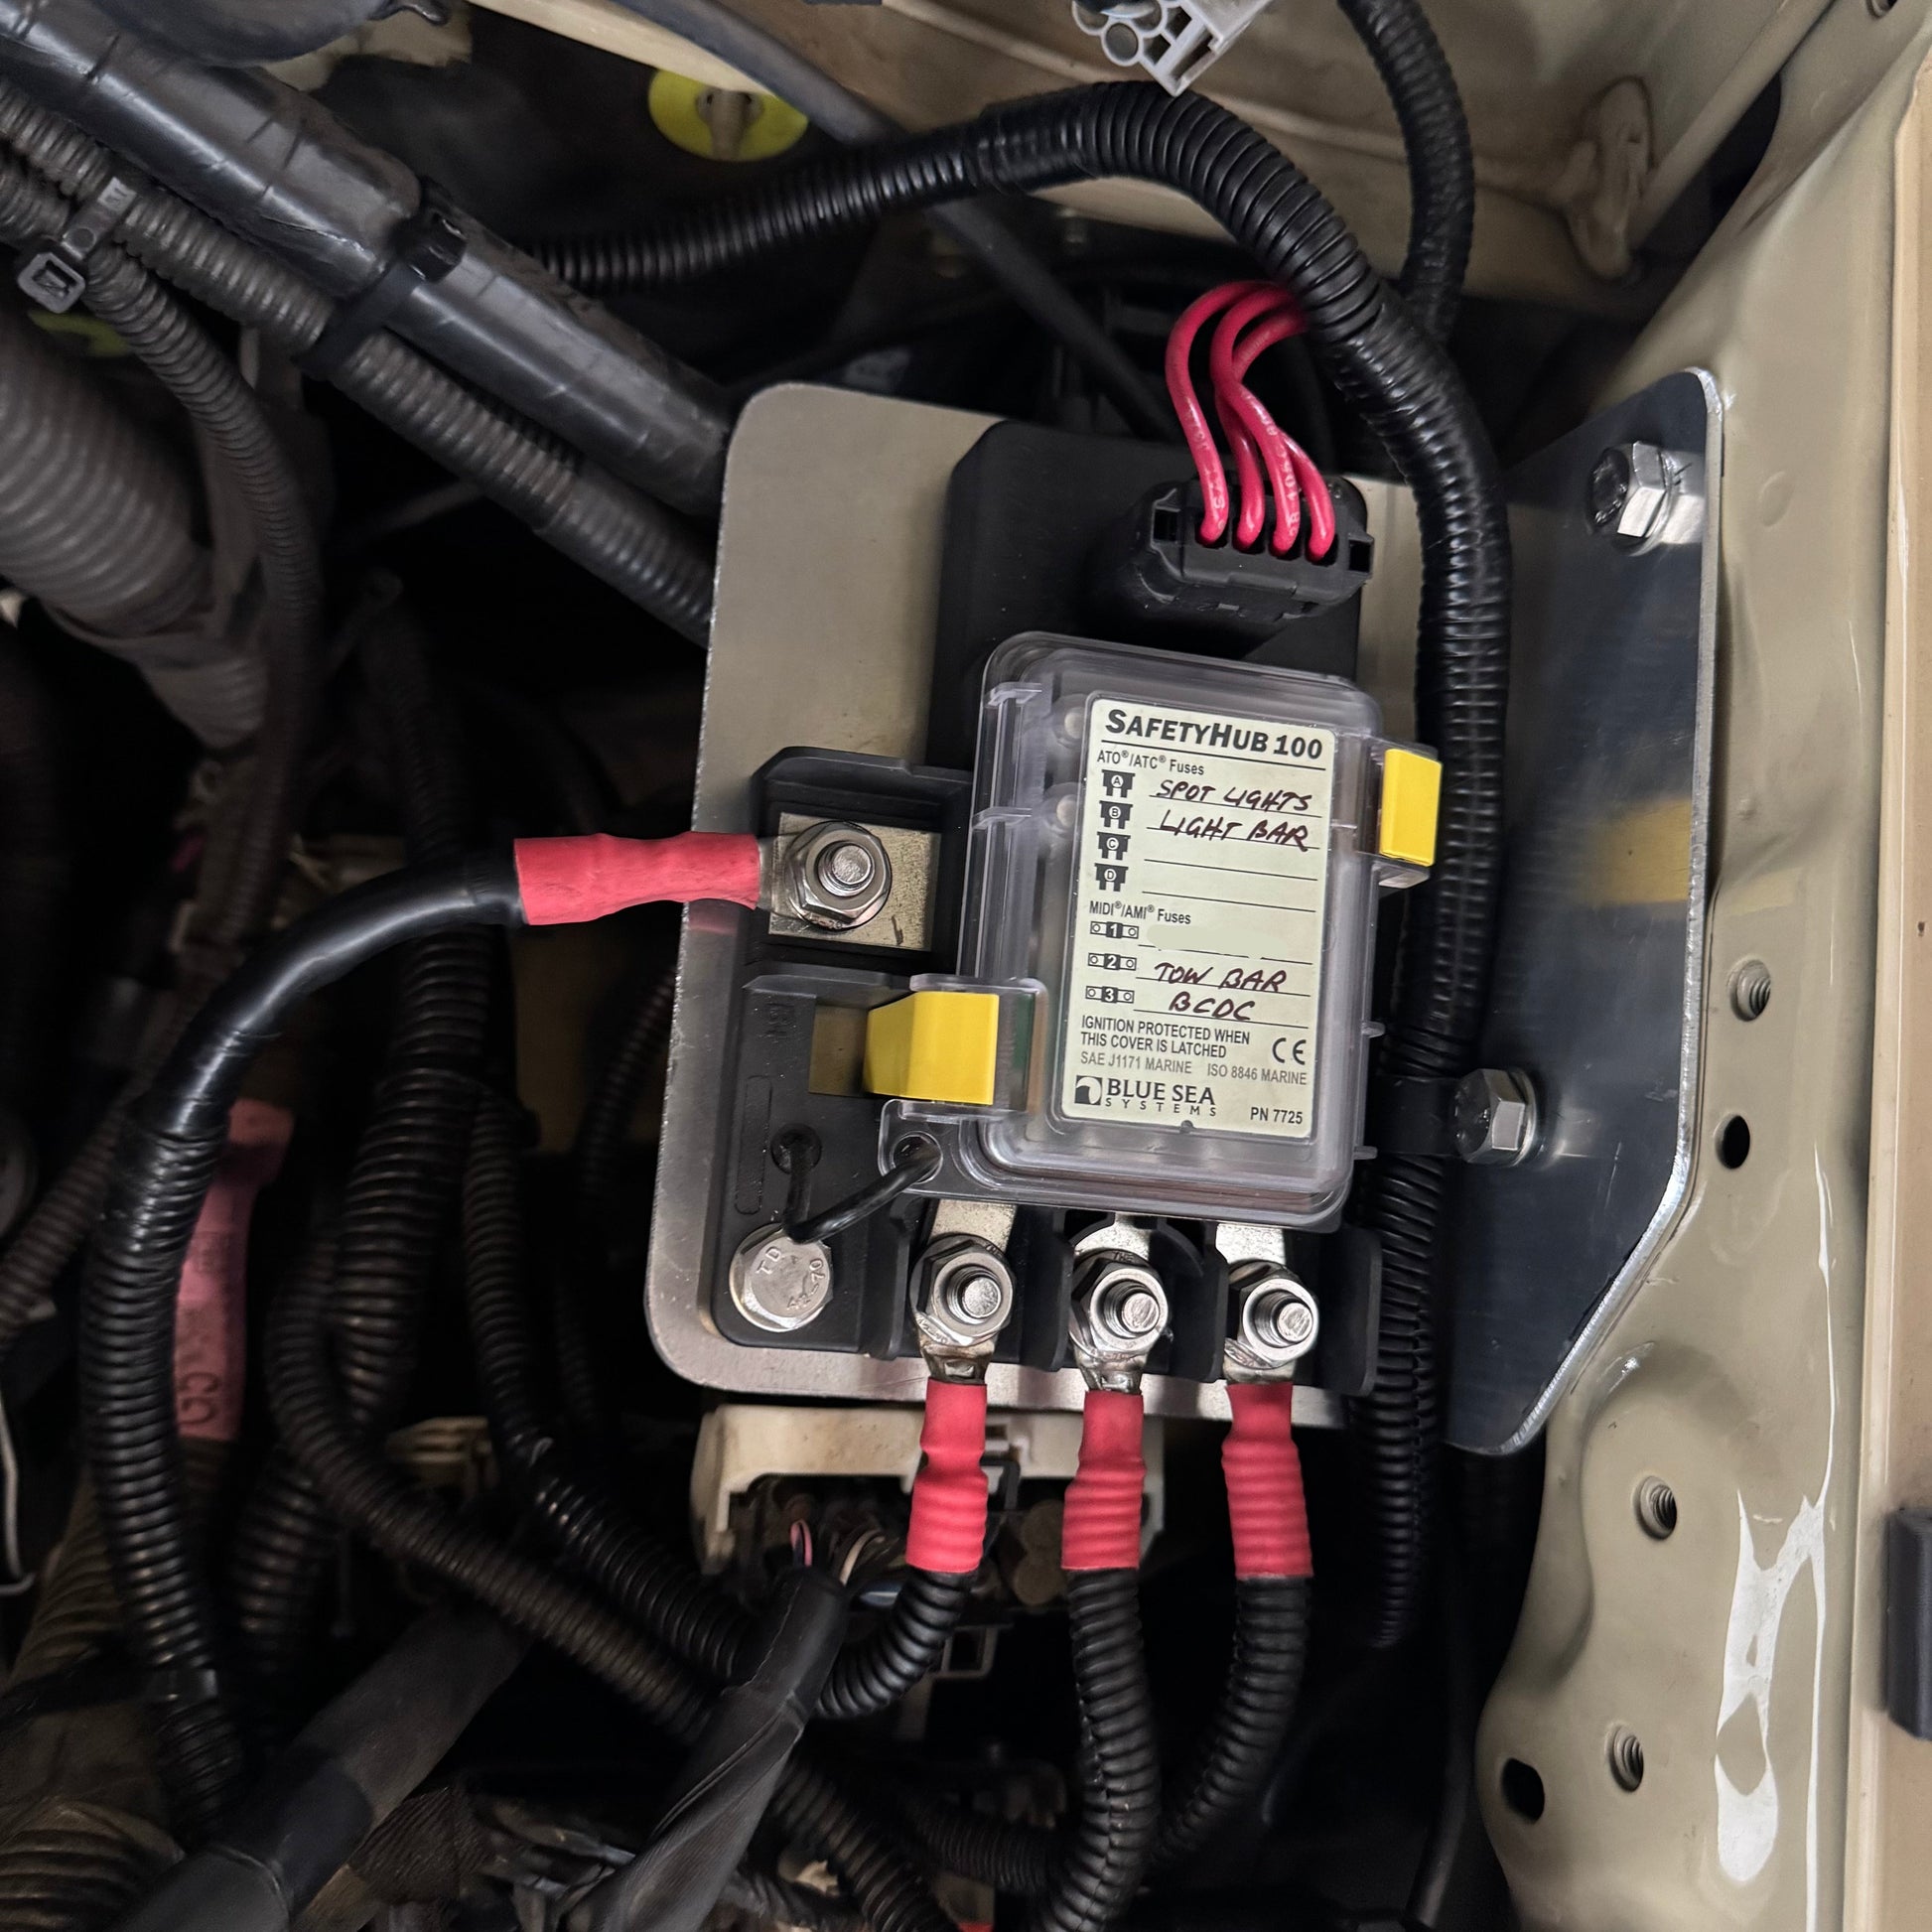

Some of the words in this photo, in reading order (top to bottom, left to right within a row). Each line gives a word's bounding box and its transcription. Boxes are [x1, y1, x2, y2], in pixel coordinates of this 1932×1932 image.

[1273, 735, 1322, 759] 100
[1170, 759, 1204, 775] Fuses
[1156, 779, 1215, 801] SPOT
[1223, 786, 1312, 812] LIGHTS
[1159, 809, 1242, 841] LIGHT
[1246, 819, 1309, 852] BAR
[1158, 908, 1191, 924] Fuses
[1155, 962, 1213, 985] TOW
[1218, 968, 1287, 993] BAR
[1169, 991, 1255, 1021] BCDC
[1081, 1016, 1134, 1034] IGNITION
[1138, 1021, 1211, 1040] PROTECTED
[1214, 1029, 1250, 1044] WHEN
[1081, 1033, 1107, 1046] THIS
[1111, 1035, 1153, 1051] COVER
[1157, 1039, 1167, 1052] IS
[1172, 1040, 1226, 1058] LATCHED
[1080, 1051, 1104, 1065] SAE
[1108, 1054, 1142, 1069] J1171
[1145, 1057, 1192, 1073] MARINE
[1207, 1063, 1228, 1077] ISO
[1231, 1065, 1258, 1080] 8846
[1261, 1068, 1307, 1085] MARINE
[1107, 1078, 1166, 1101] BLUE
[1172, 1084, 1215, 1105] SEA
[1105, 1097, 1216, 1117] SYSTEMS
[1250, 1107, 1269, 1121] PN
[1273, 1109, 1303, 1124] 7725
